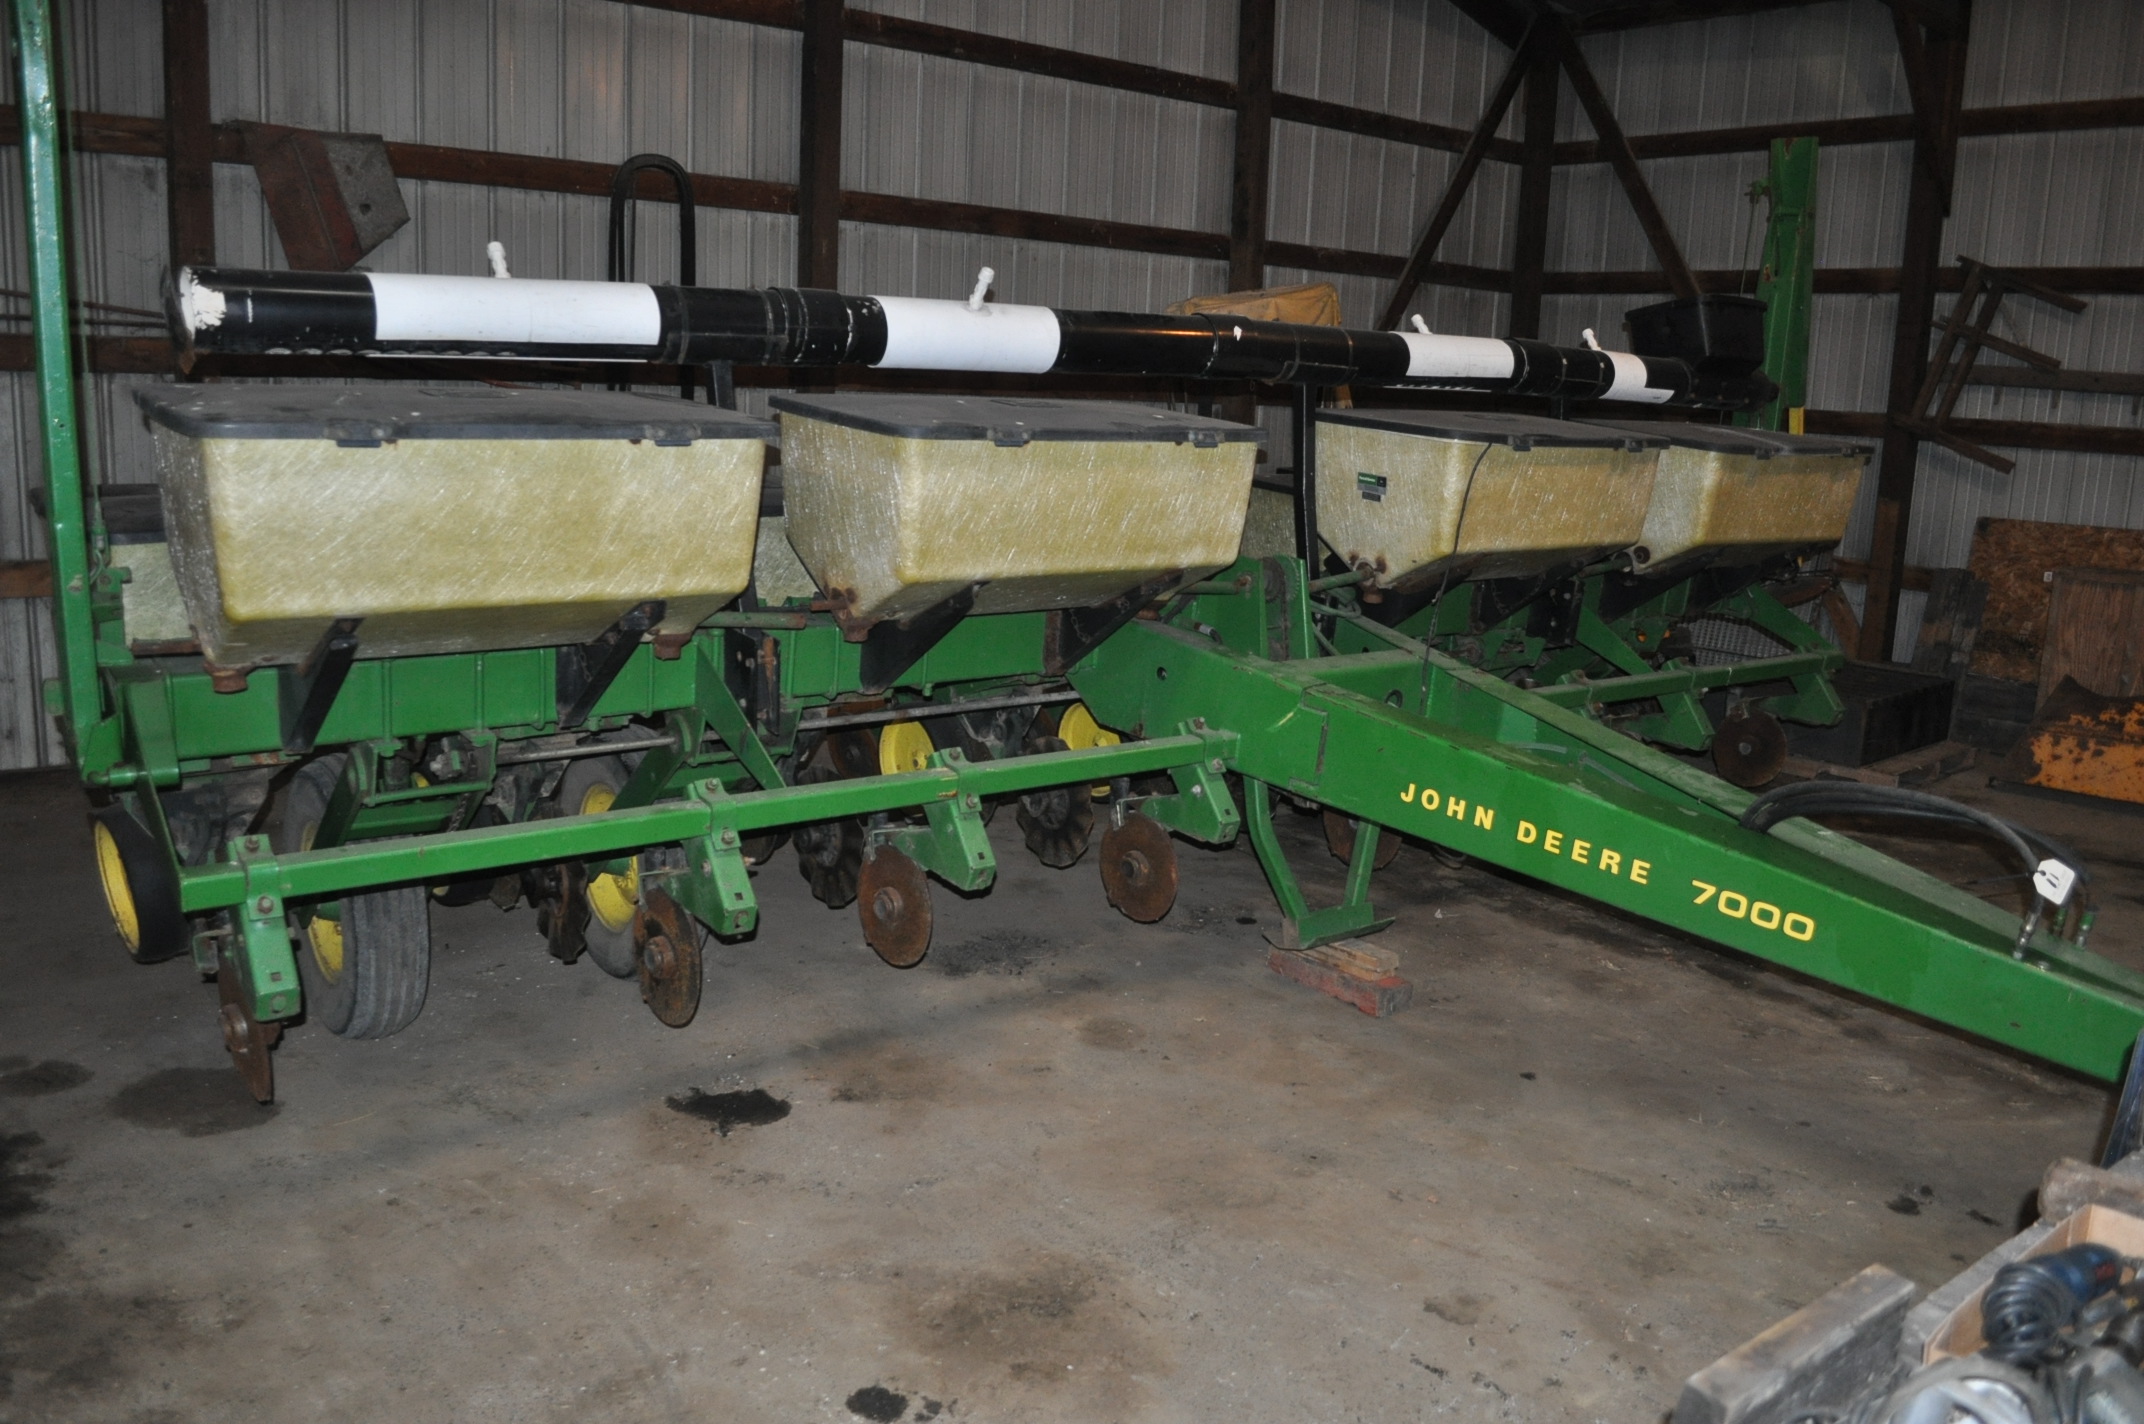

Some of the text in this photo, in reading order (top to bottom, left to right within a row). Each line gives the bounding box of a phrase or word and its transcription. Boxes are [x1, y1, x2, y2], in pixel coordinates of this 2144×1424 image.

[1400, 783, 1816, 942] JOHN DEERE 7000
